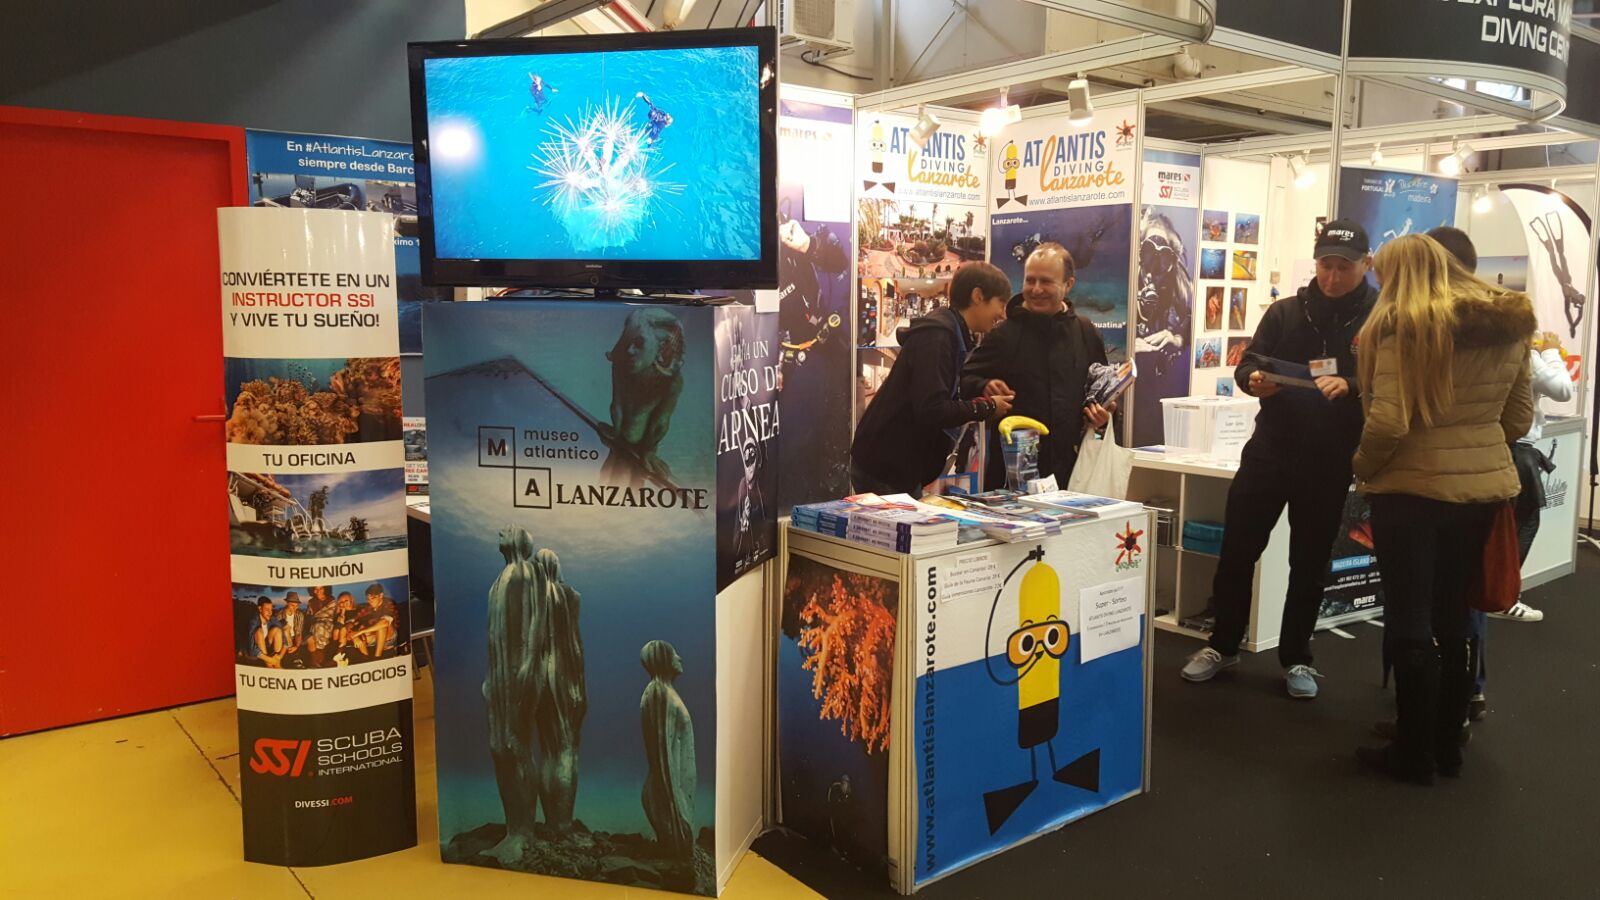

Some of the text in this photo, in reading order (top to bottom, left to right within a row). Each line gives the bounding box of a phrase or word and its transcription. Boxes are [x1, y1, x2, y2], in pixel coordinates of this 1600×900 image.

[1481, 15, 1547, 52] DIVING
[287, 141, 303, 152] En
[298, 158, 414, 175] siempre desde Barc
[920, 159, 965, 173] DIVING
[1054, 161, 1104, 177] DIVING
[1158, 171, 1182, 182] mares
[1029, 191, 1125, 206] www.atlantislanzarote.com
[1159, 185, 1173, 199] SSI
[222, 269, 390, 288] CONVIÉRTETE EN UN
[232, 292, 375, 308] INSTRUCTOR SSI
[230, 311, 380, 327] Y VIVE TU SUEÑO!
[753, 341, 769, 359] UN
[721, 368, 759, 402] CURSO
[524, 429, 579, 442] museo
[717, 400, 780, 455] APNEA
[487, 438, 507, 456] M
[524, 445, 599, 461] atlantico
[262, 452, 356, 466] TU OFICINA
[524, 478, 709, 510] A LANZAROTE
[267, 562, 364, 579] TU REUNIÓN
[239, 665, 407, 691] TU CENA DE NEGOCIOS
[923, 566, 937, 873] www.atlantislanzarote.com
[317, 727, 402, 752] SCUBA
[249, 738, 312, 777] SSI
[317, 742, 403, 766] SCHOOLS
[318, 756, 403, 776] INTERNATIONAL
[295, 796, 353, 809] DIVESSI.COM
